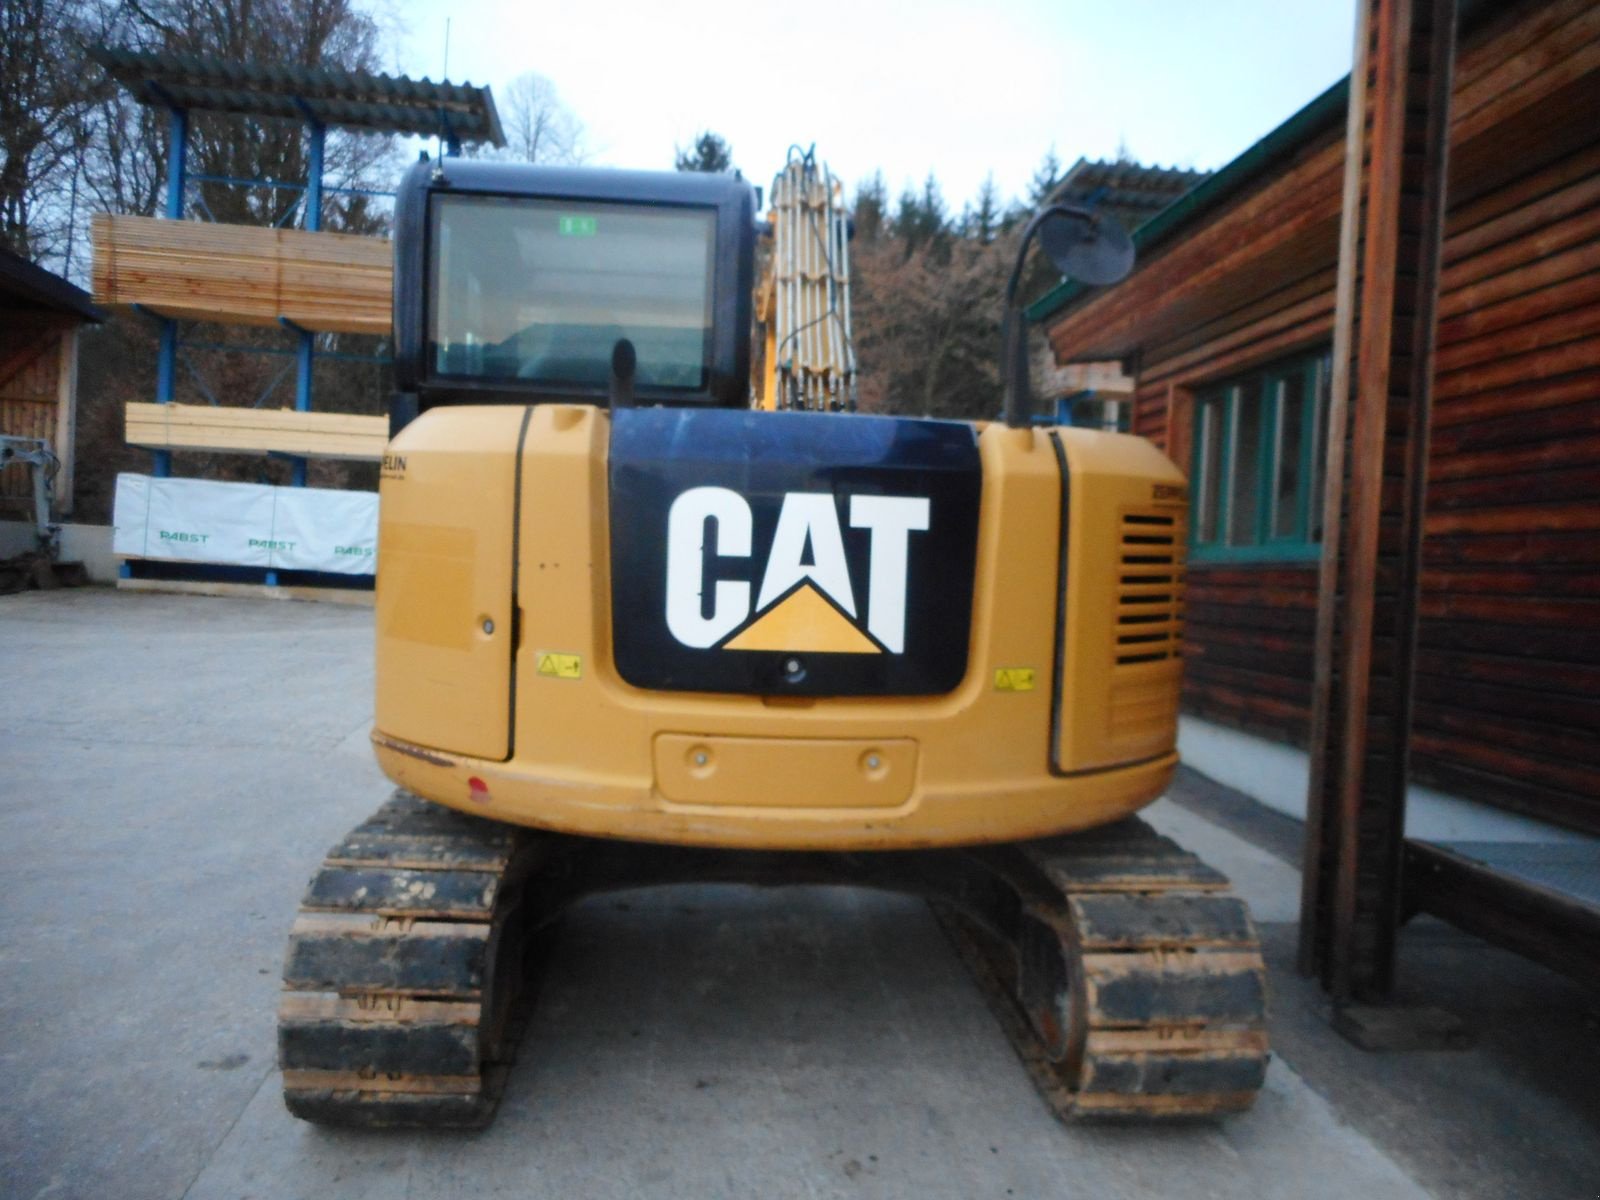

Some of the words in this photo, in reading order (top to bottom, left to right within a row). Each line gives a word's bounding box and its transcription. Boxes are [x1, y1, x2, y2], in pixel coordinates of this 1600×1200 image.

[381, 455, 407, 471] ELIN
[159, 530, 210, 543] PABST
[249, 538, 297, 551] PABST
[334, 545, 374, 556] PABS
[665, 486, 931, 654] CAT
